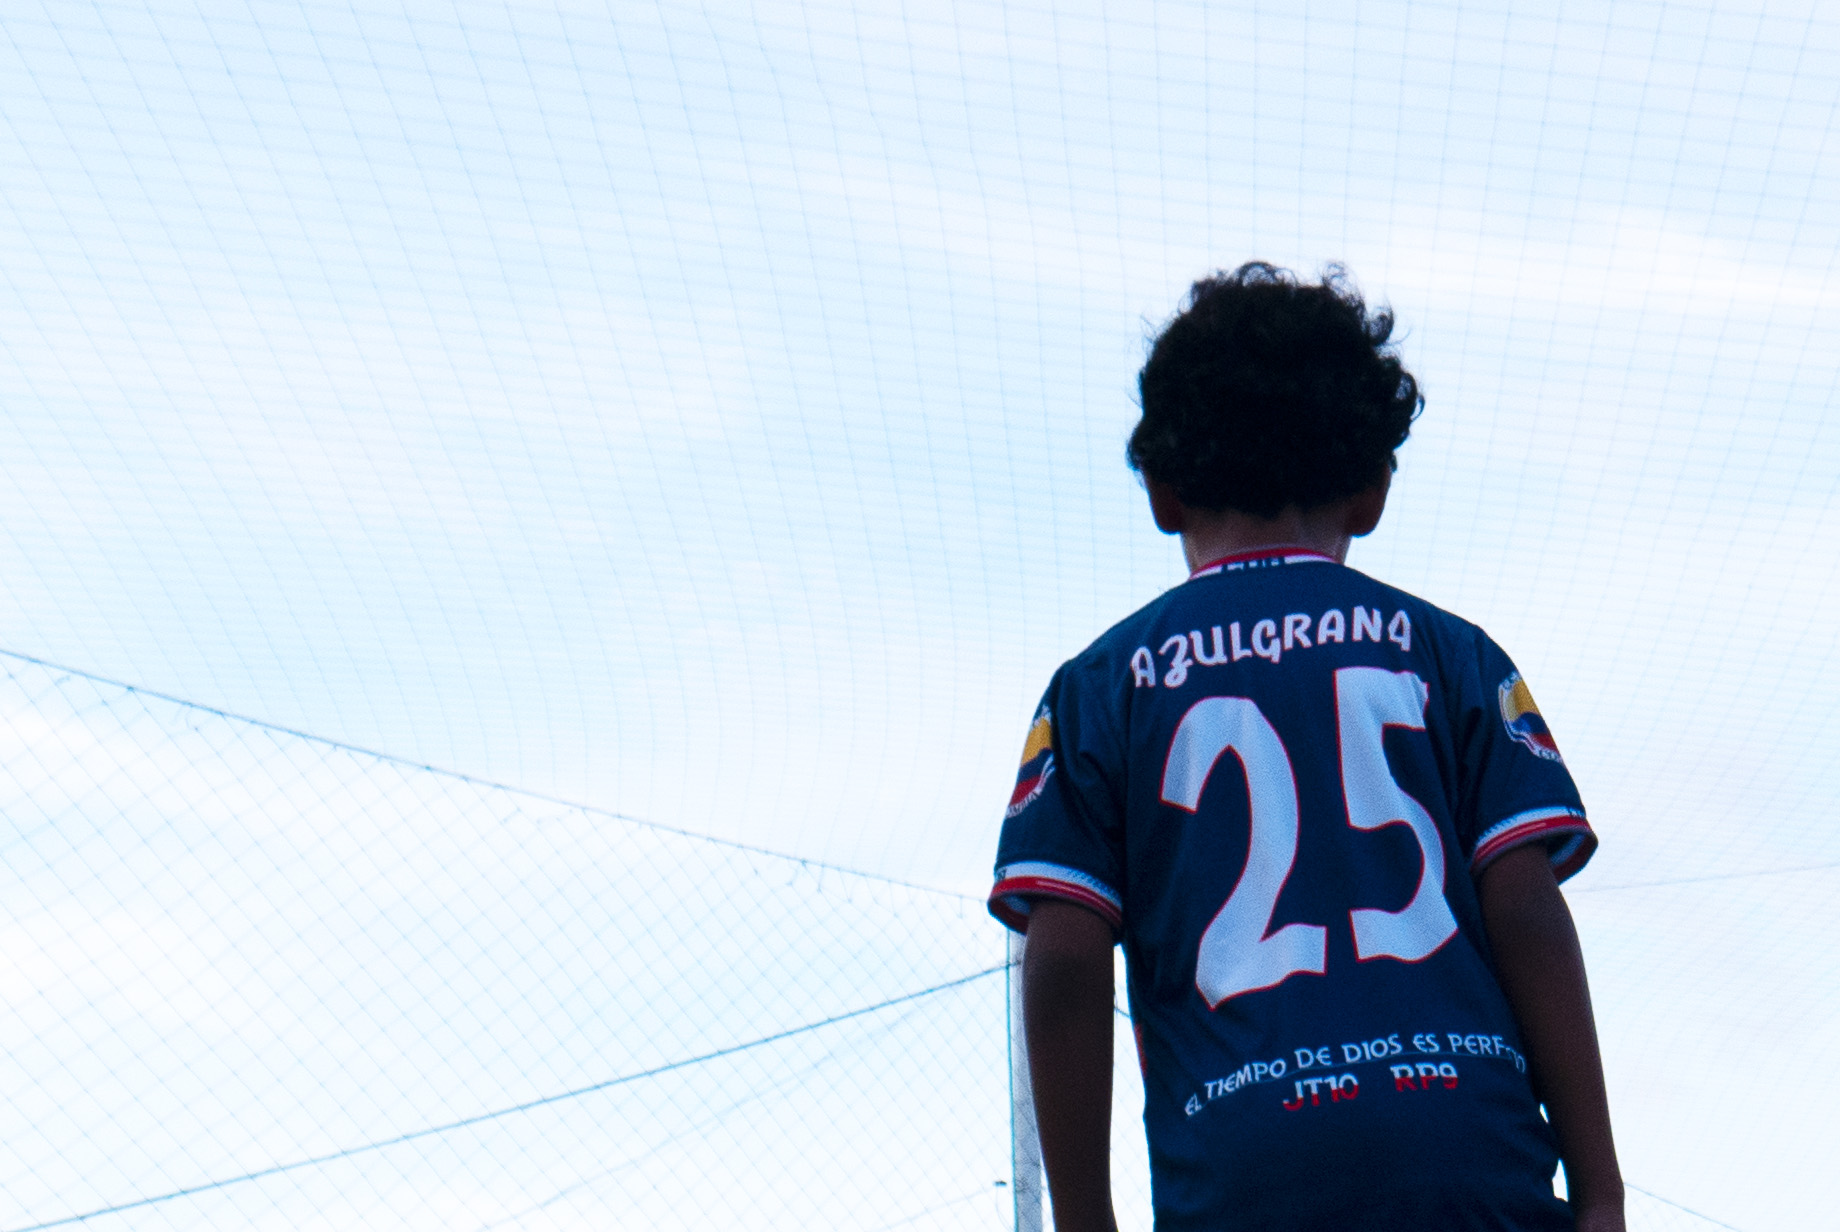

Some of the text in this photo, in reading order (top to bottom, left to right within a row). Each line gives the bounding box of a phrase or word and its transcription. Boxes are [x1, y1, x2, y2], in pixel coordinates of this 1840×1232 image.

[1131, 605, 1411, 689] AZULGRANA
[1160, 665, 1459, 1011] 25
[1184, 1092, 1203, 1117] EL
[1204, 1058, 1287, 1101] TIEMPO
[1294, 1047, 1332, 1069] DE
[1341, 1033, 1402, 1064] DIOS
[1412, 1032, 1440, 1054] ES
[1282, 1062, 1458, 1112] JT10 RP9
